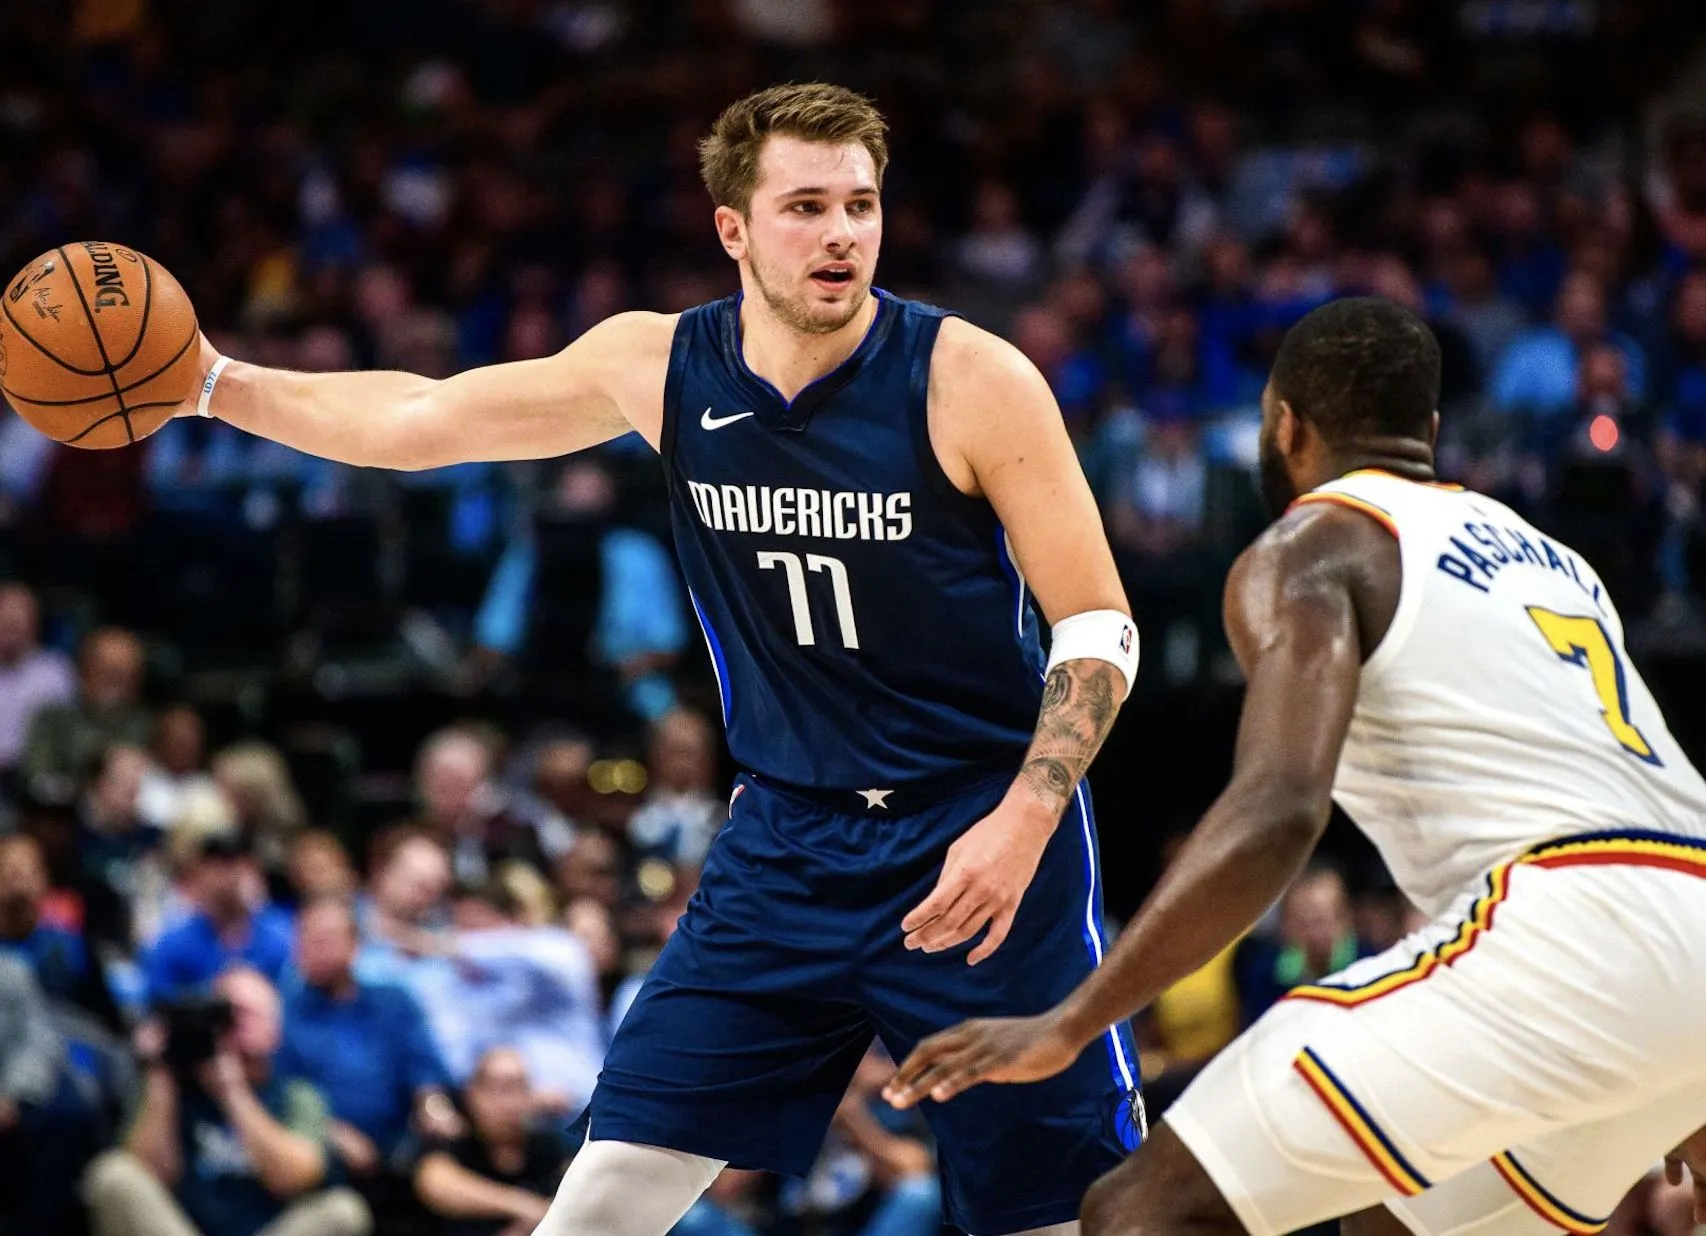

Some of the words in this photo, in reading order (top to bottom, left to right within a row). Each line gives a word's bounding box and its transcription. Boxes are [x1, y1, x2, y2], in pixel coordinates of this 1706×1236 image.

[687, 480, 913, 541] MAVERICKS
[756, 551, 860, 649] 77
[1524, 604, 1666, 769] 7
